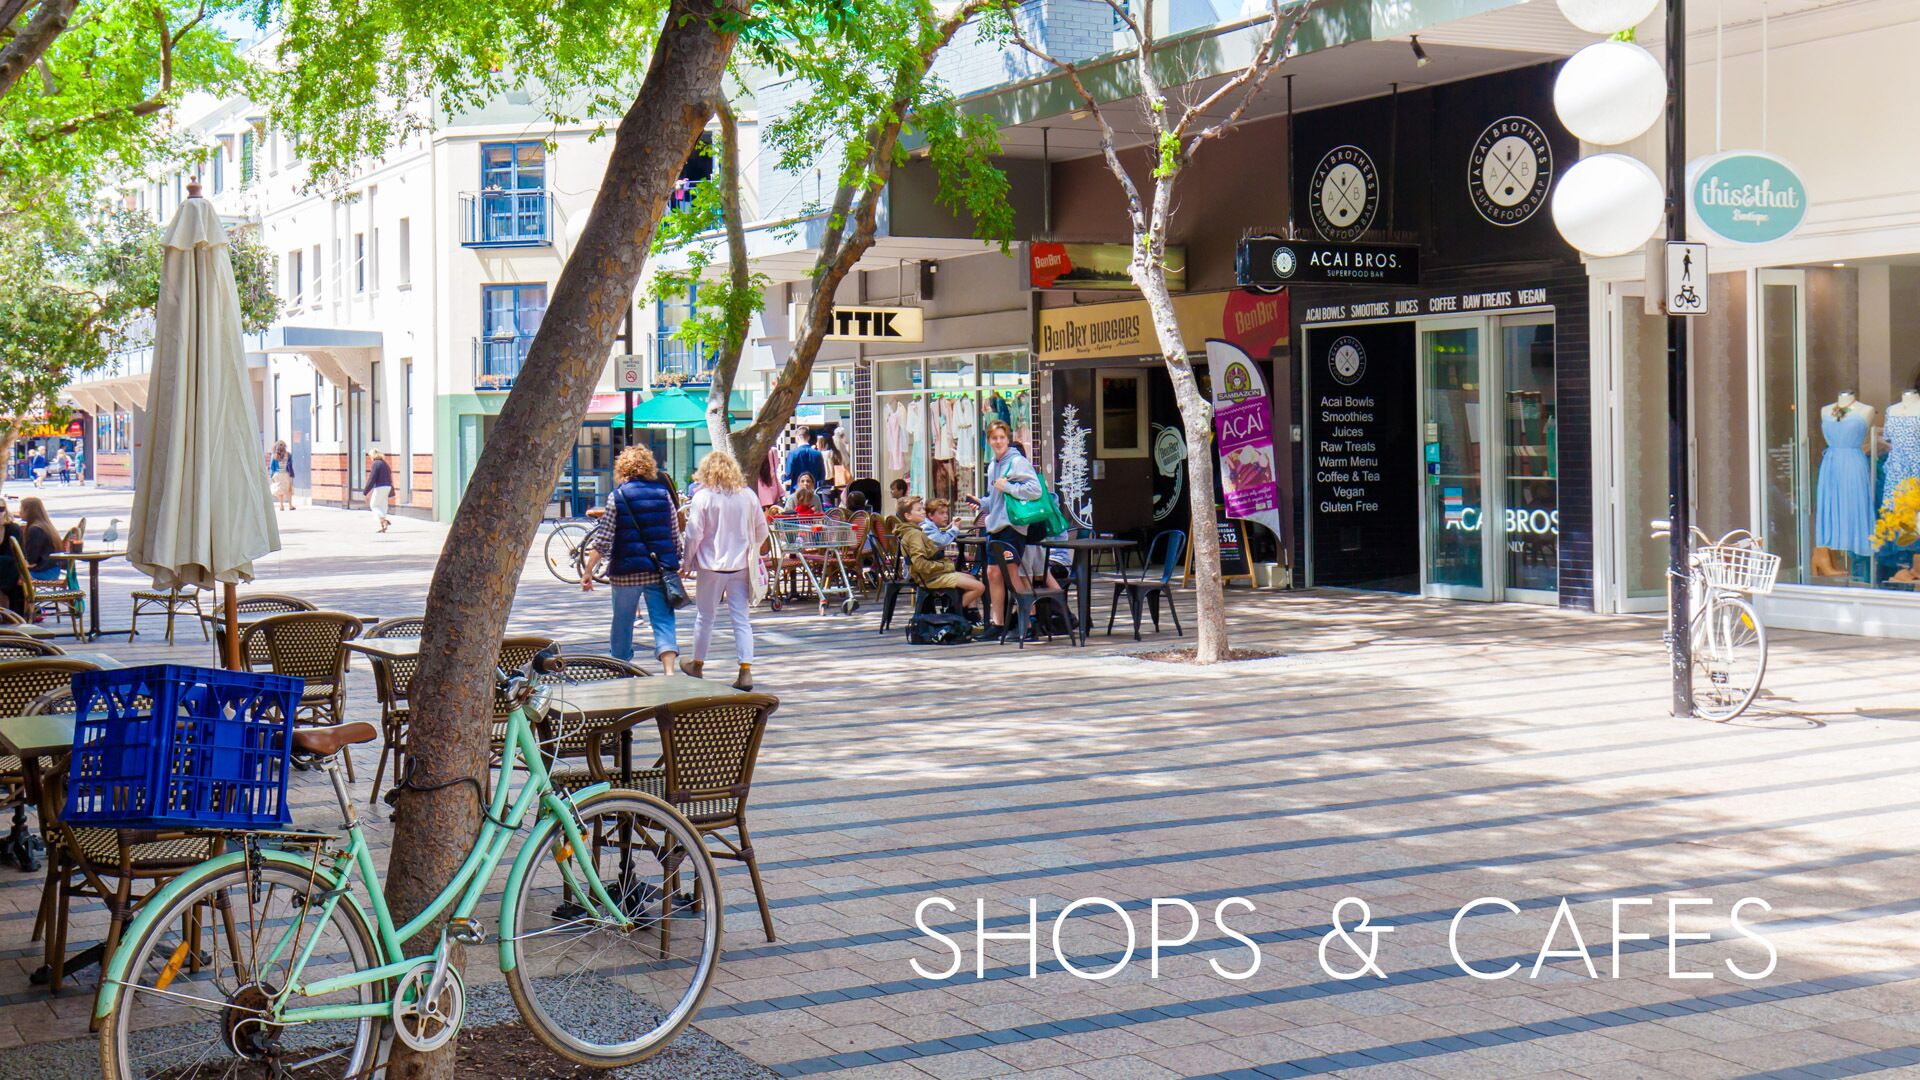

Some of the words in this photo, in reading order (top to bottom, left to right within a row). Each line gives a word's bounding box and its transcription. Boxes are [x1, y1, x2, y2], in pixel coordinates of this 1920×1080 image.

[1473, 137, 1491, 176] ACAI
[1493, 122, 1547, 164] BROTHERS
[1313, 163, 1329, 198] ACAI
[1330, 150, 1375, 189] BROTHERS
[1476, 188, 1530, 220] SUPERFOOD
[1361, 203, 1374, 225] BAR
[1310, 251, 1348, 267] ACAI
[1355, 252, 1402, 268] BROS.
[1327, 269, 1369, 277] SUPERFOOD
[1370, 270, 1384, 278] BAR
[1305, 307, 1321, 321] ACAI
[1322, 306, 1345, 320] BOWLS
[1351, 302, 1389, 318] SMOOTHIES
[1395, 300, 1419, 314] JUICES
[1429, 296, 1456, 312] COFFEE
[1463, 295, 1480, 309] RAW
[1482, 292, 1511, 308] TREATS
[1518, 288, 1546, 304] VEGAN
[1321, 396, 1342, 407] Acai
[1345, 396, 1374, 407] Bowls
[1322, 411, 1374, 422] Smoothies
[1223, 407, 1263, 440] AÇAÍ
[1332, 426, 1364, 437] Juices
[1321, 441, 1342, 452] Raw
[1345, 441, 1376, 452] Treats
[1318, 456, 1347, 467] Warm
[1350, 456, 1378, 467] Menu
[1317, 471, 1350, 482] Coffee
[1352, 471, 1360, 482] &
[1362, 471, 1380, 481] Tea
[1333, 486, 1365, 500] Vegan
[1320, 501, 1353, 512] Gluten
[1355, 501, 1378, 511] Free
